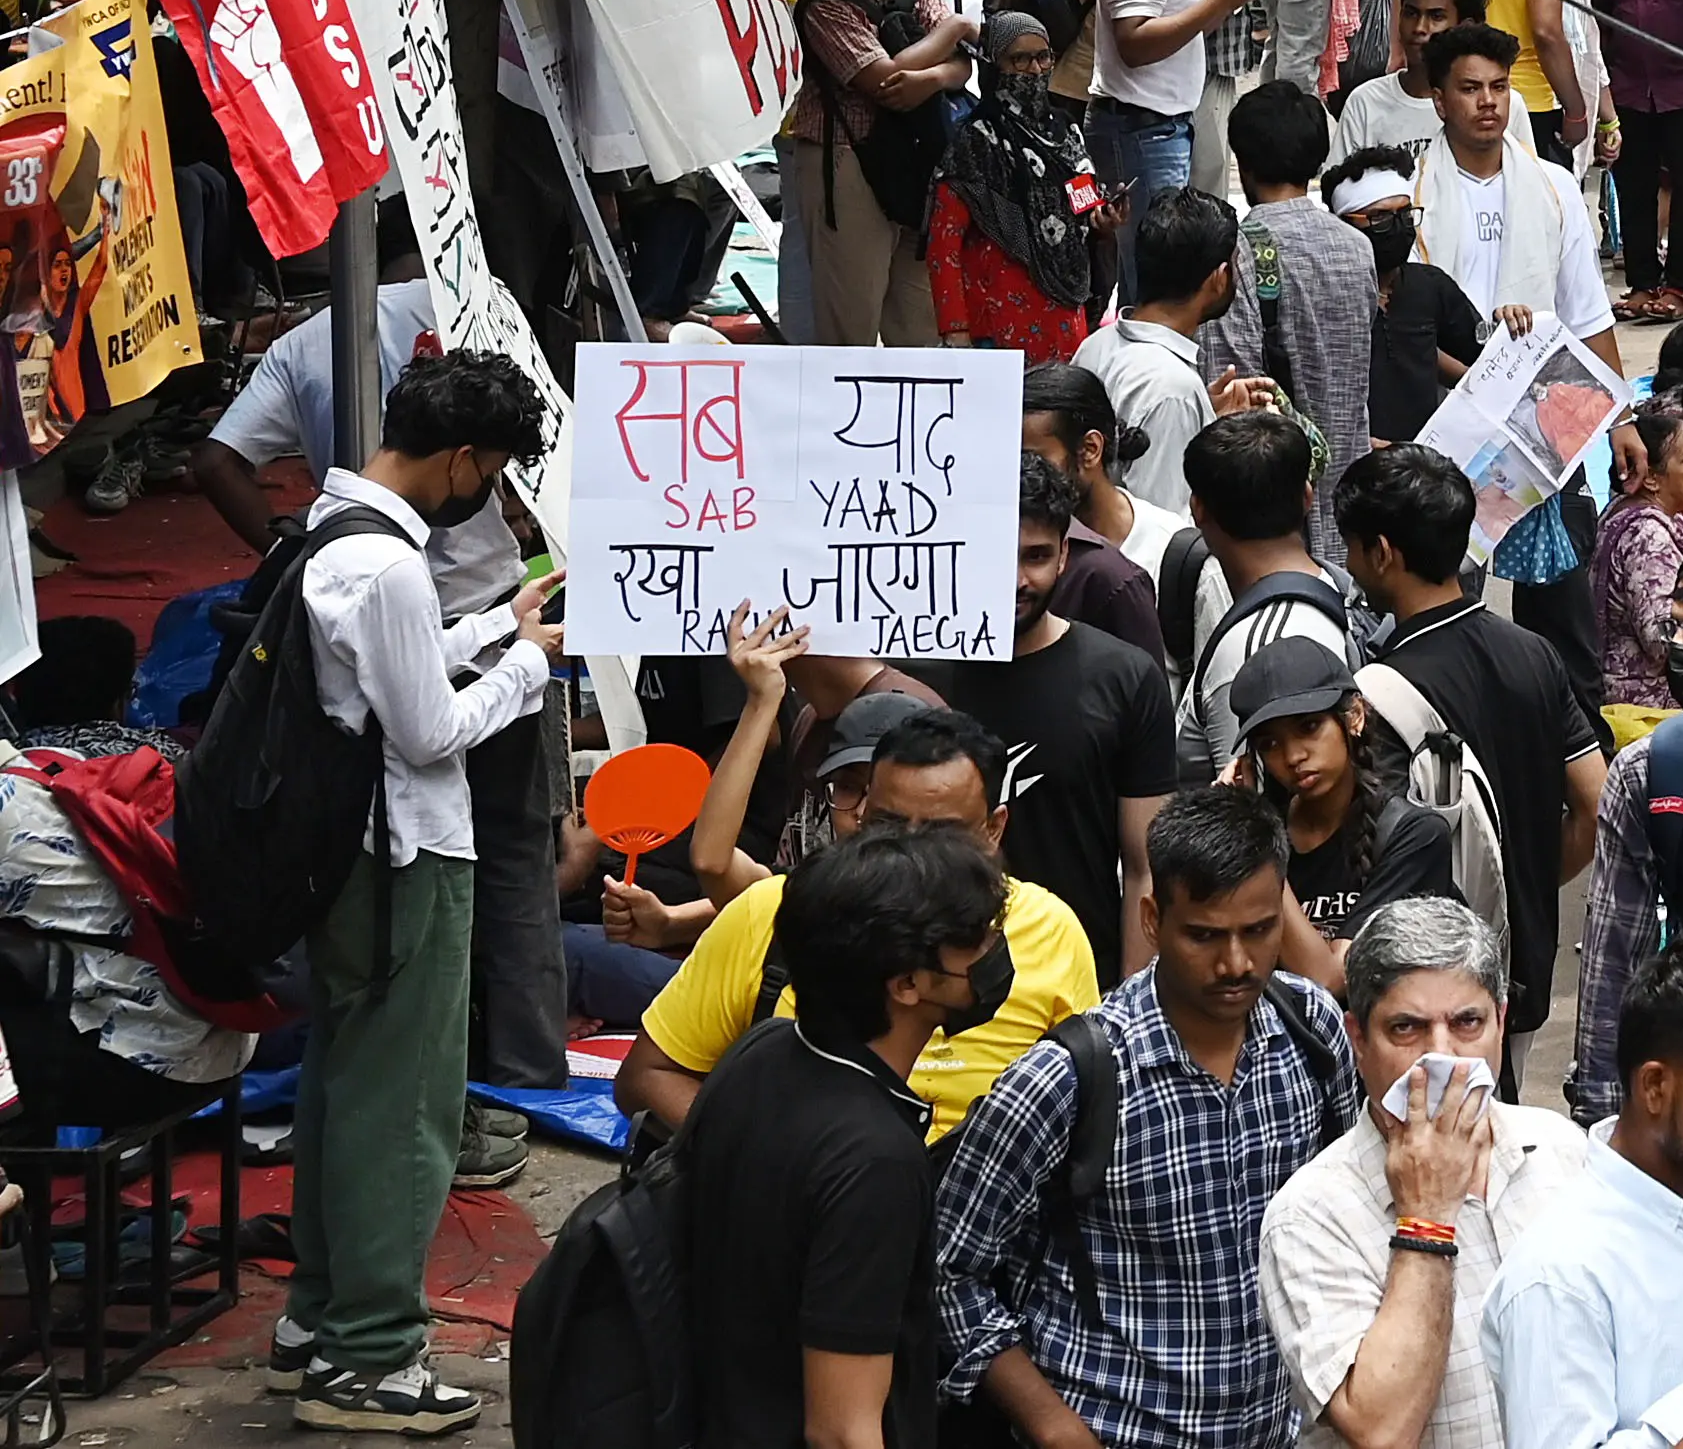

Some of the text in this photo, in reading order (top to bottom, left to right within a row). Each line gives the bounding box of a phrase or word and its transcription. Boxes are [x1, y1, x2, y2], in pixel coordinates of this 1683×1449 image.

[615, 360, 965, 497] सब याद
[663, 477, 937, 538] SAB YAAD
[609, 541, 967, 623] रखा जाएगा
[869, 609, 997, 657] JAEGA
